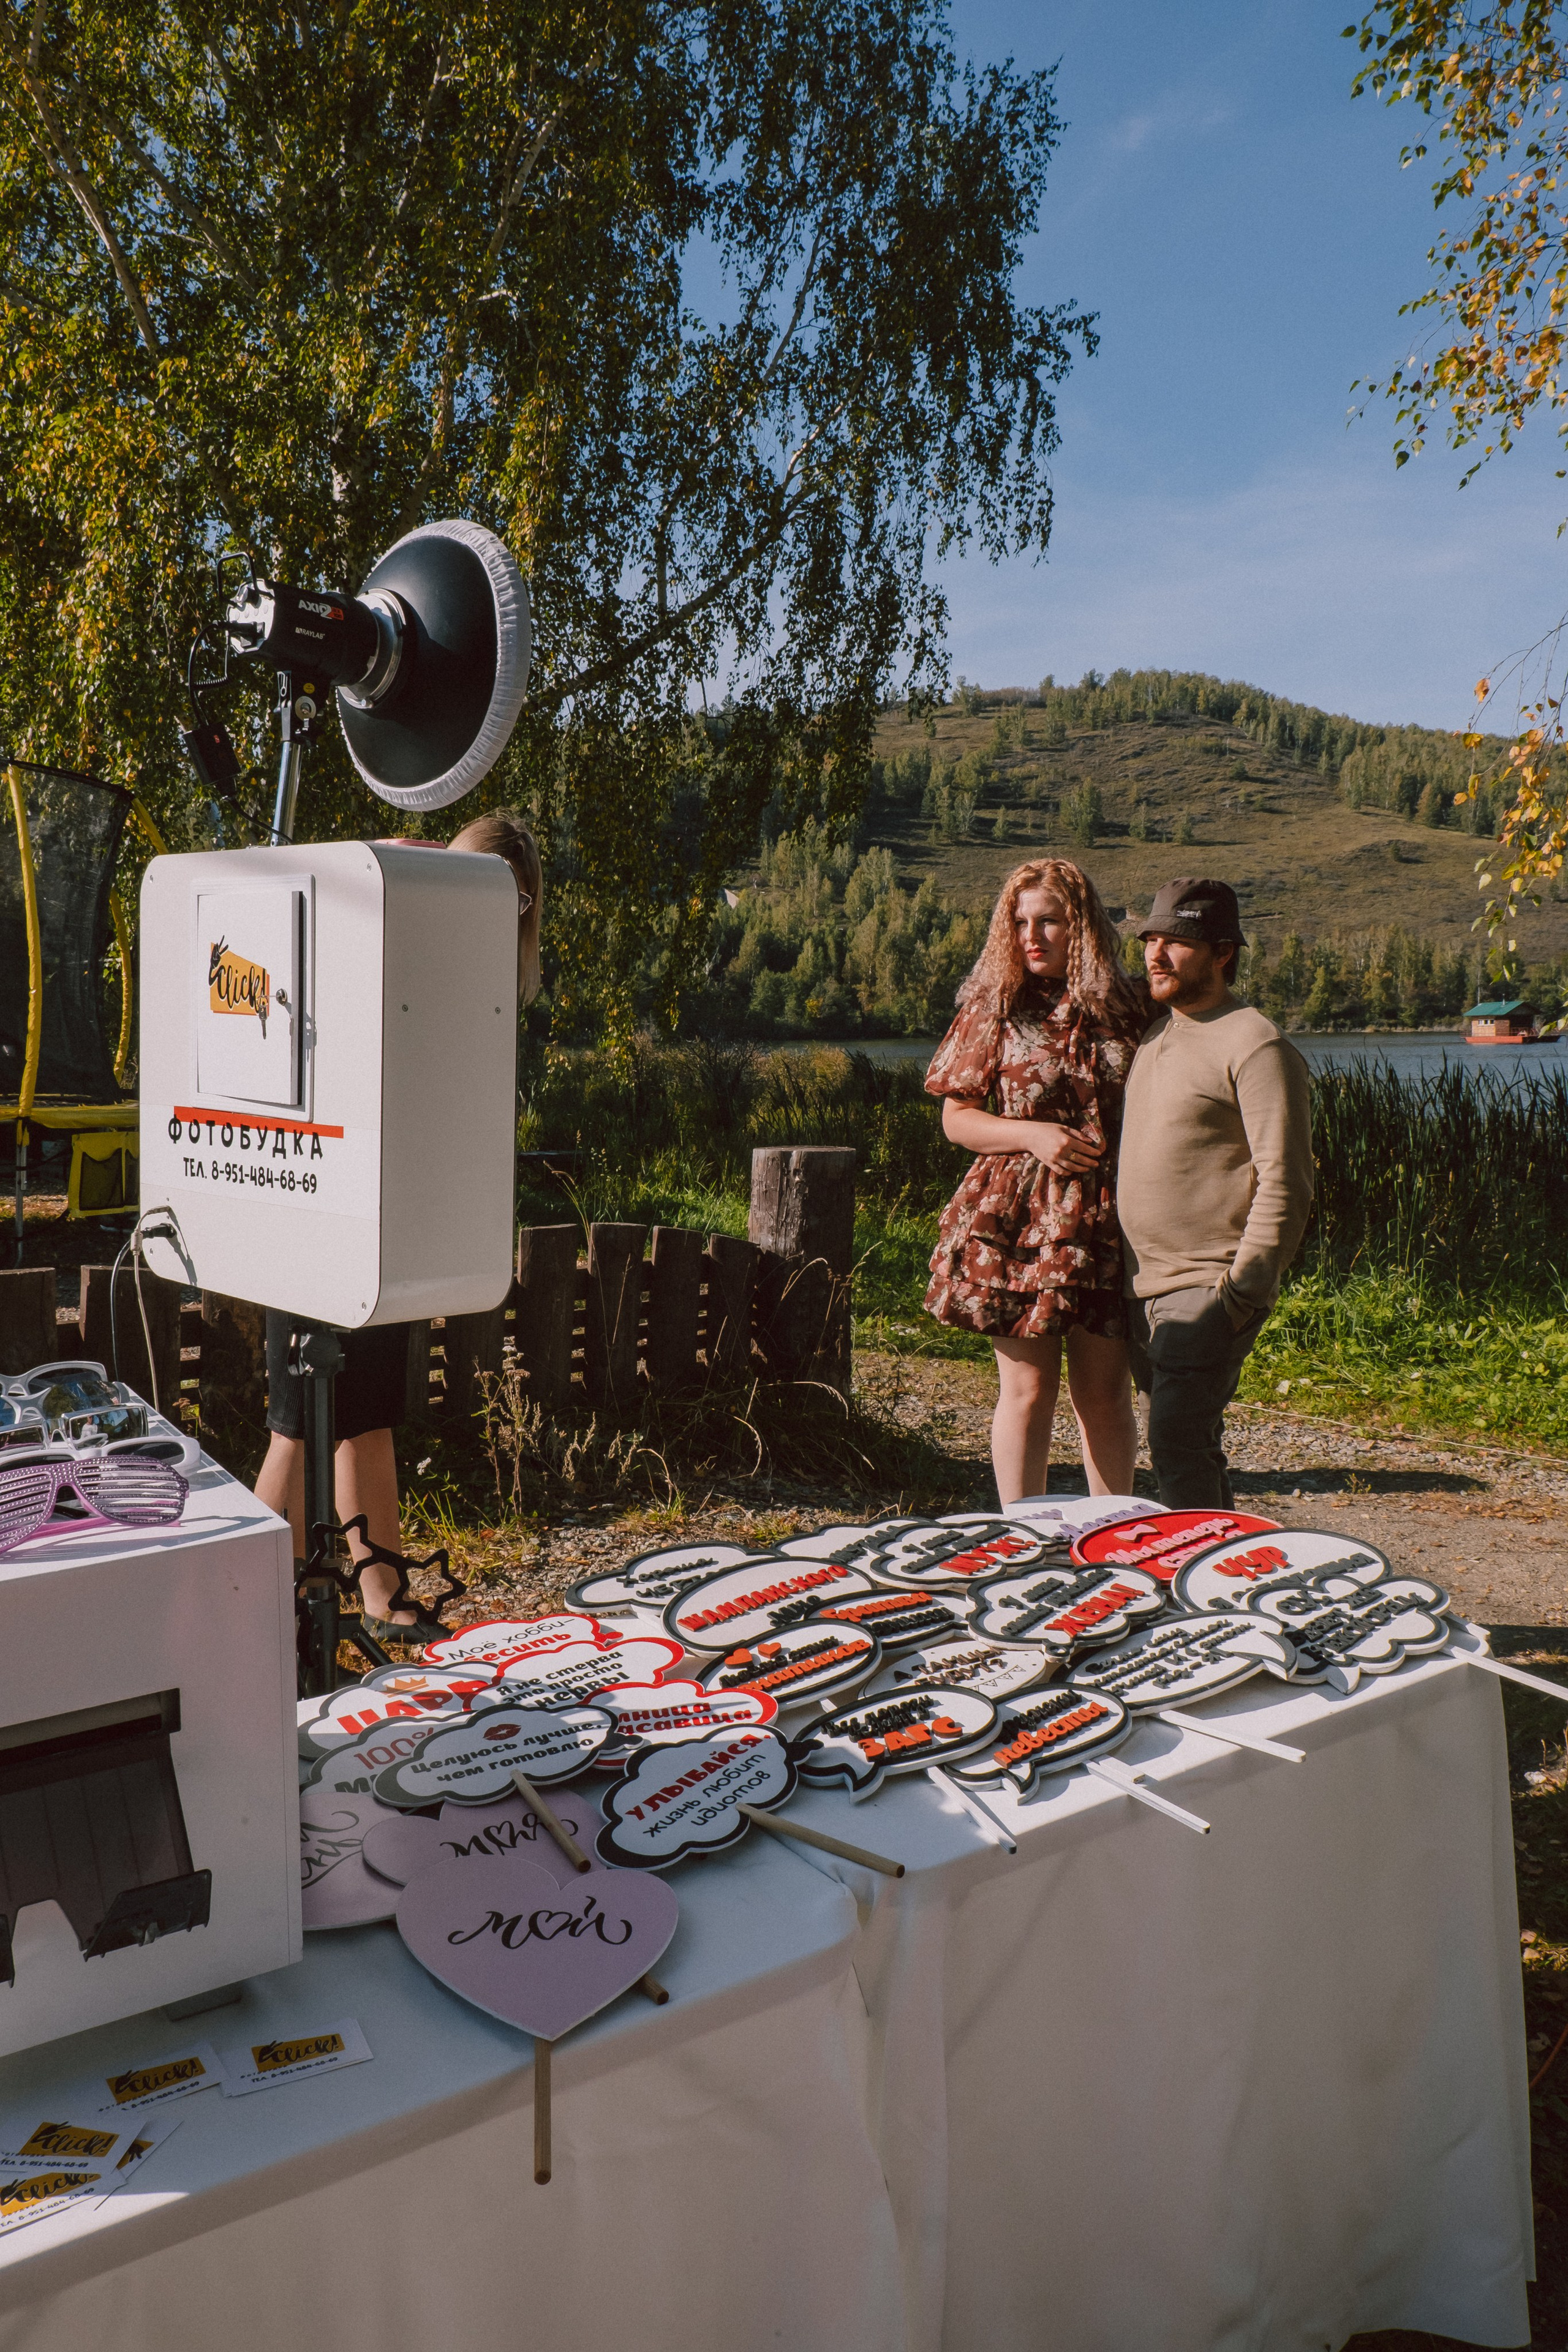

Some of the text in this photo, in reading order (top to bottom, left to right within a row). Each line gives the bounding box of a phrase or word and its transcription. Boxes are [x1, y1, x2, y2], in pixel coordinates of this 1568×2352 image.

[168, 1114, 323, 1159] ФОТОБУДКА
[183, 1157, 317, 1194] ТЕЛ. 8-951-484-68-69
[938, 1536, 1038, 1576] МУЖ!
[1104, 1518, 1235, 1565] Мы теперь
[1212, 1545, 1289, 1581] ЧУР
[677, 1565, 848, 1632] ШАМПАНСКОГО
[1044, 1583, 1145, 1638] ЖЕНА!
[448, 1640, 498, 1660] Моё
[911, 1646, 1003, 1675] ТАНЦЫ
[496, 1651, 624, 1696] Я не стерва
[503, 1663, 623, 1703] это просто
[534, 1672, 630, 1708] нервы
[617, 1709, 753, 1734] асавица
[858, 1716, 963, 1762] ЗАГС
[993, 1702, 1109, 1769] невесты
[410, 1743, 518, 1773] Целуюсь
[437, 1738, 594, 1782] чем готовлю
[643, 1754, 766, 1838] жизнь любит
[691, 1770, 771, 1826] идиотов
